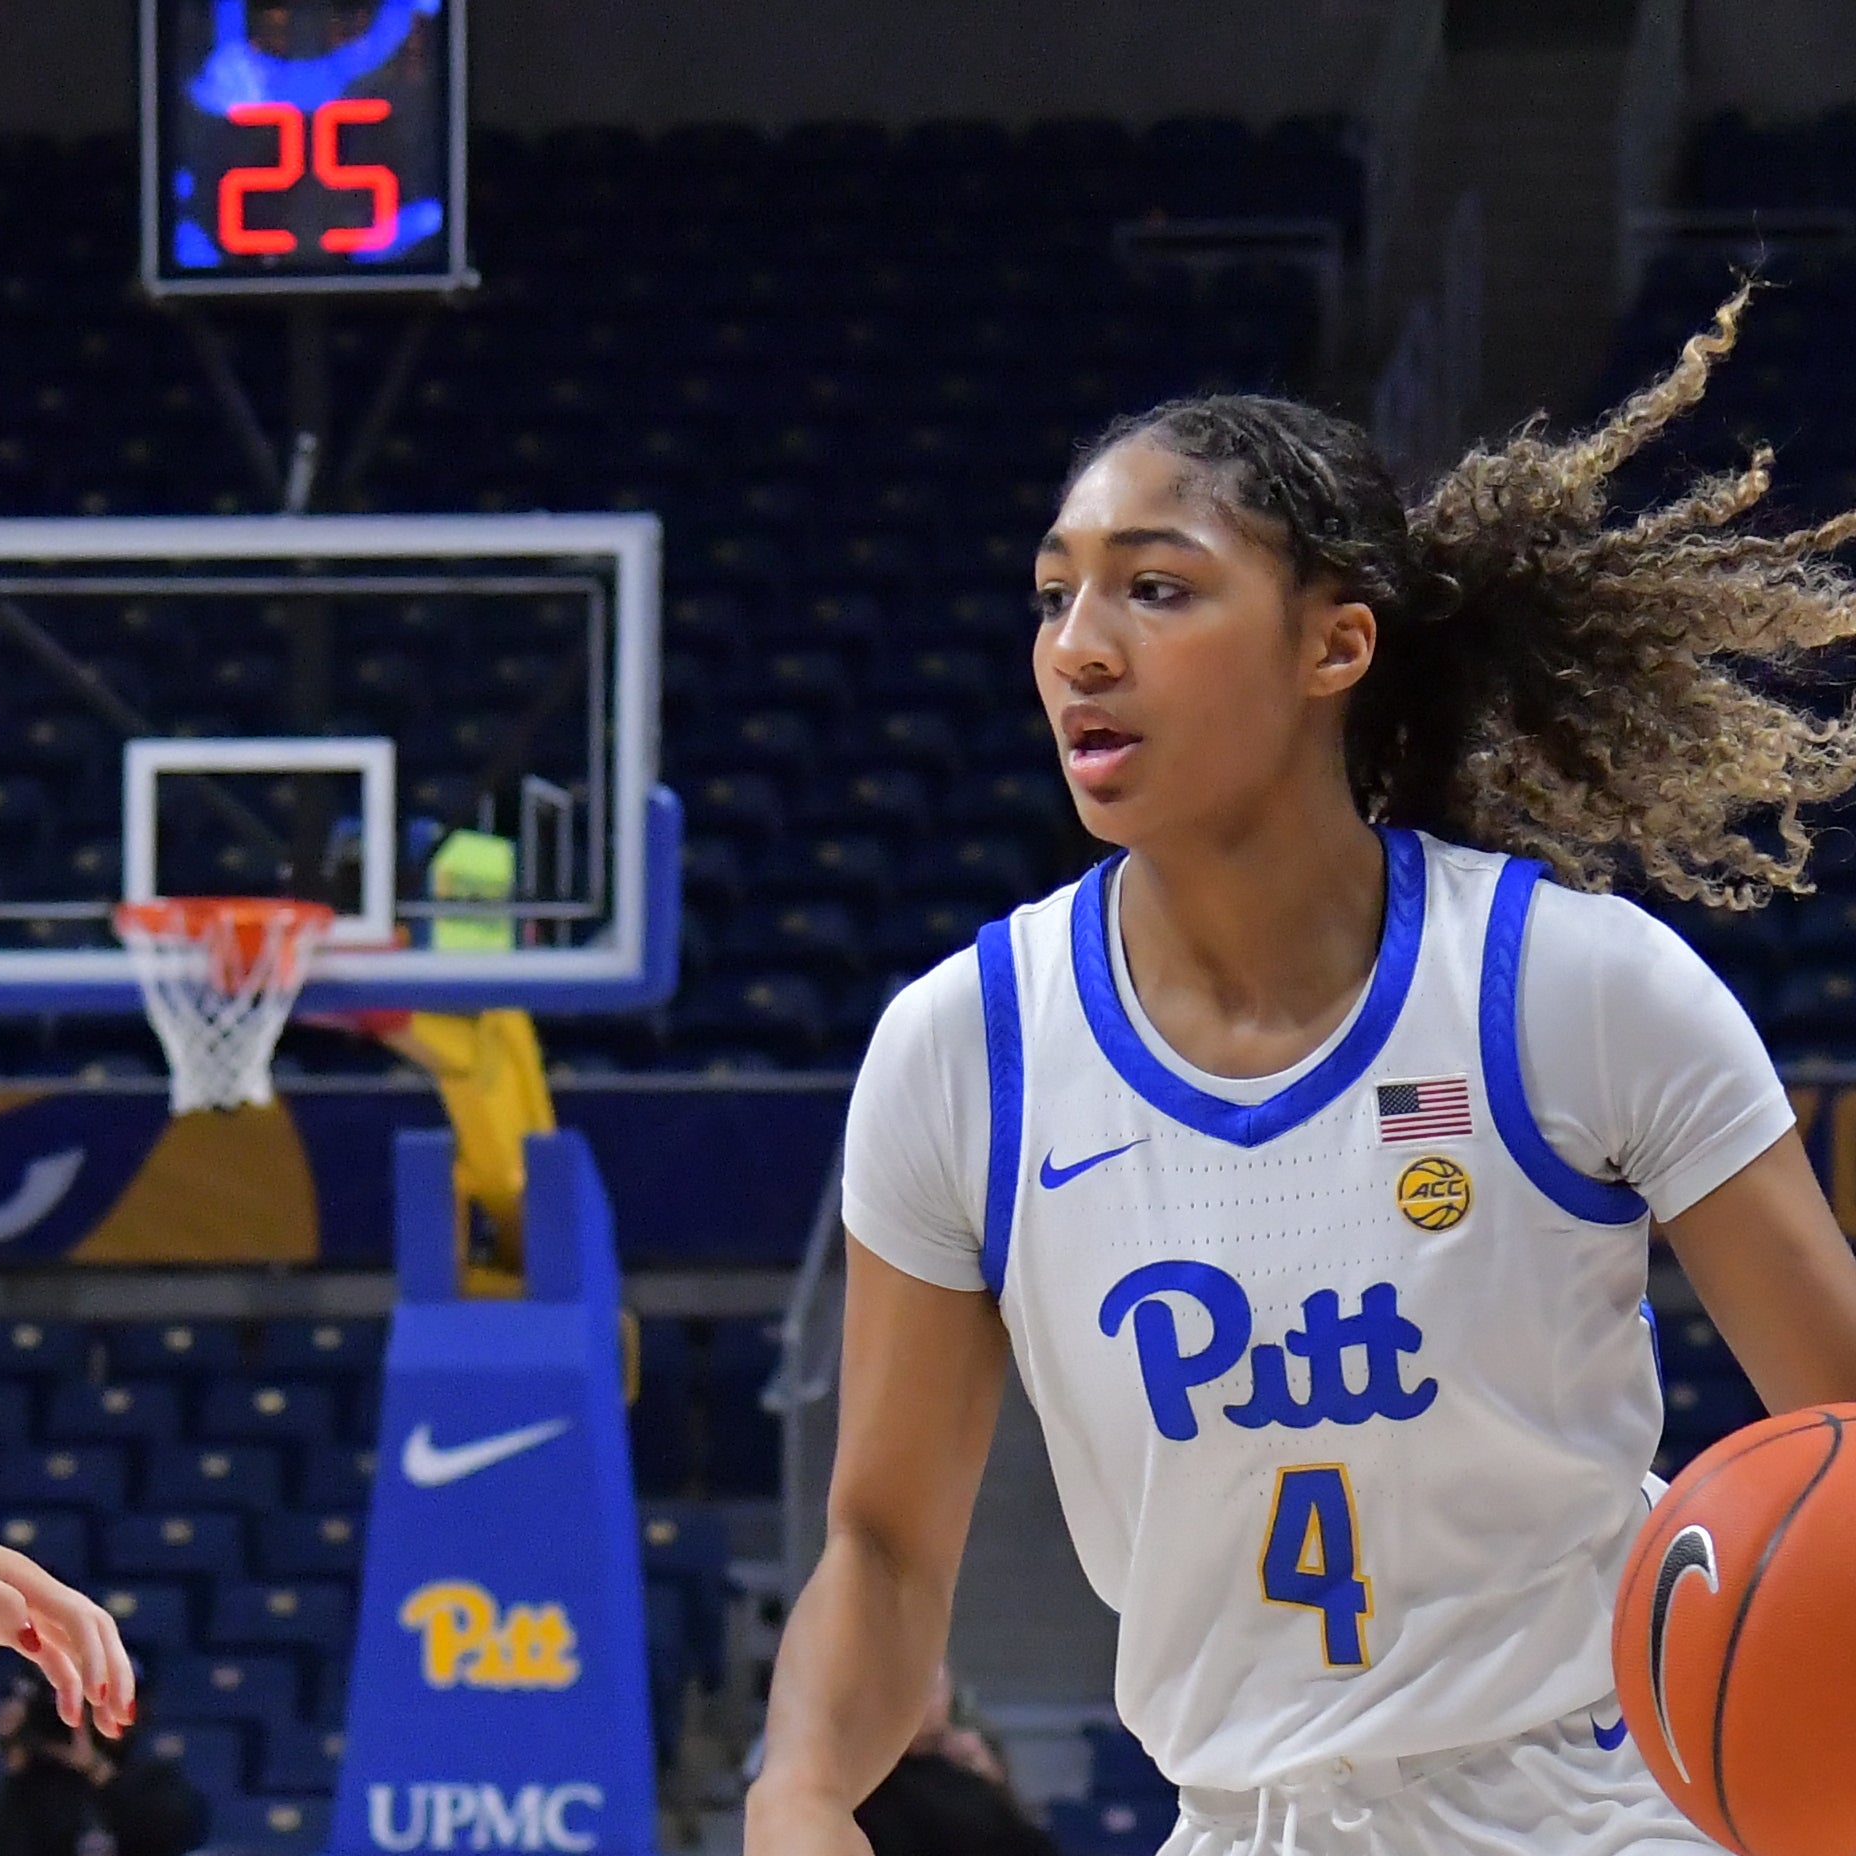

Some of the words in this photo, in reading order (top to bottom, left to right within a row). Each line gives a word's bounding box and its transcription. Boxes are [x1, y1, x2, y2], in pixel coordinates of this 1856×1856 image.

[218, 98, 400, 255] 25
[1408, 1179, 1465, 1199] ACC
[1098, 1259, 1438, 1441] Pitt
[1257, 1462, 1374, 1668] 4
[400, 1579, 582, 1691] Pitt
[367, 1780, 606, 1855] UPMC
